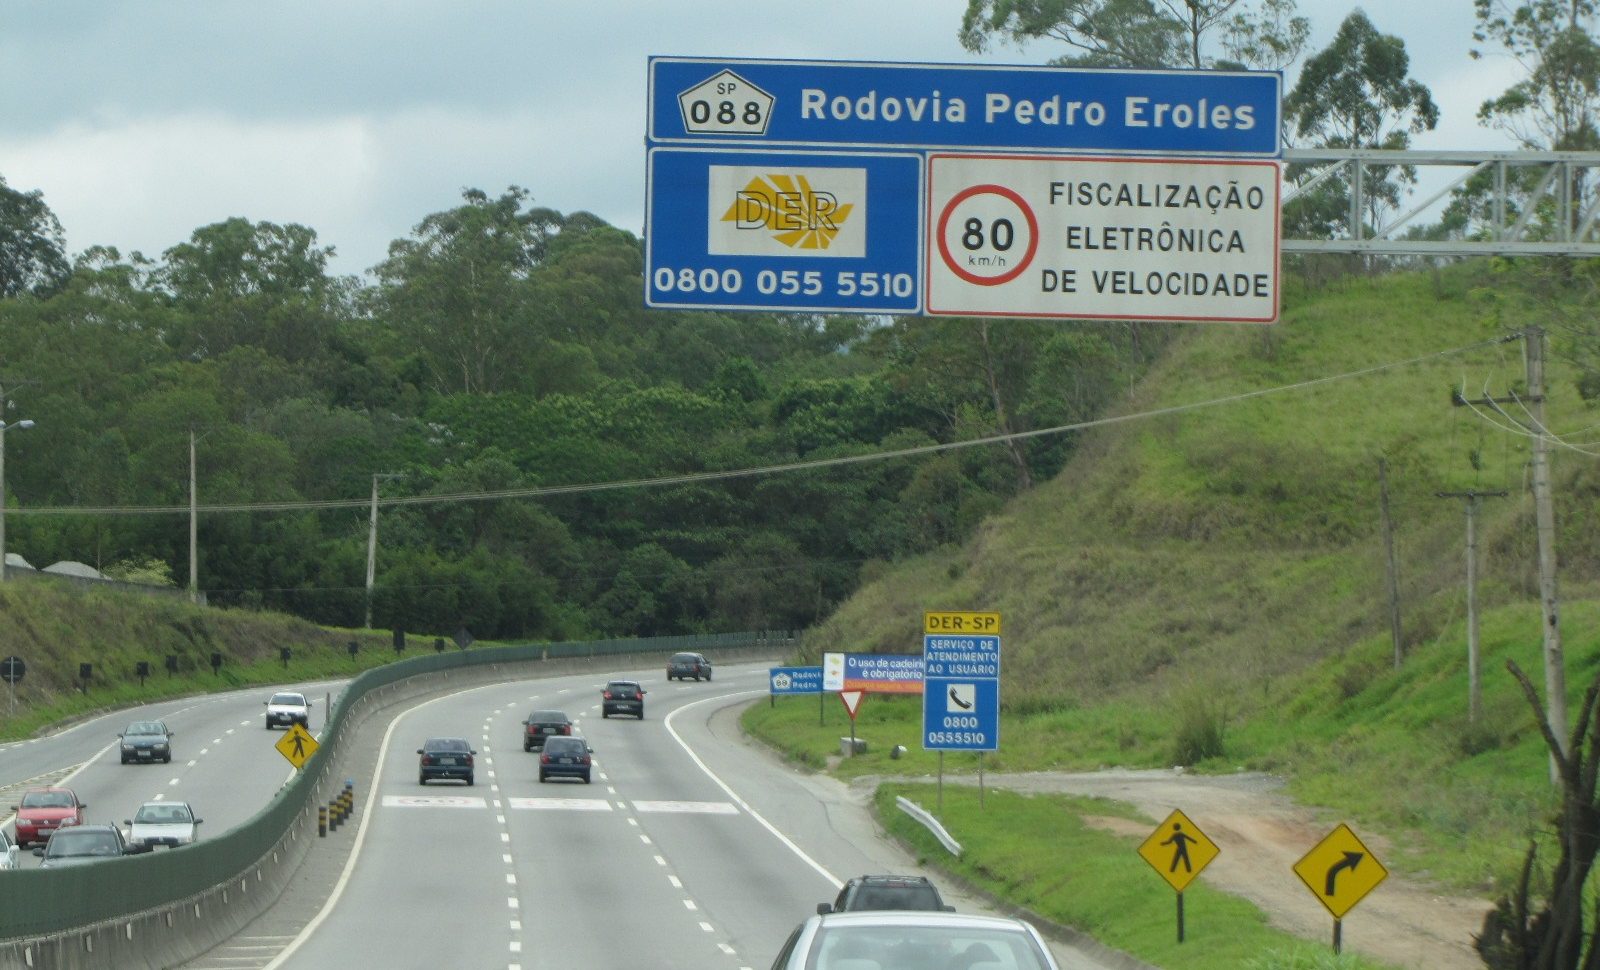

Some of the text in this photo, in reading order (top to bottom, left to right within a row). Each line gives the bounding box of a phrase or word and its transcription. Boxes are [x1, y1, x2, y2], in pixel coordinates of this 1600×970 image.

[717, 83, 736, 95] SP
[690, 100, 761, 125] 088
[801, 88, 1255, 130] Rodovia Pedro Eroles
[1049, 180, 1264, 214] FISCALIZAÇÃO
[736, 191, 840, 231] DER
[962, 217, 1014, 252] 80
[1066, 221, 1245, 254] ELETRÔNICA
[967, 254, 1006, 267] km/h
[654, 267, 913, 298] 0800 055 5510
[1042, 269, 1269, 298] DE VELOCIDADE
[929, 616, 995, 629] DER-SP
[930, 639, 994, 651] SERVIÇO DE
[848, 657, 856, 667] O
[876, 659, 889, 668] de
[927, 651, 997, 662] ATENDIMENTO
[928, 663, 995, 674] AO USUÁRIO
[943, 716, 977, 728] 0800
[928, 732, 985, 744] 0555510
